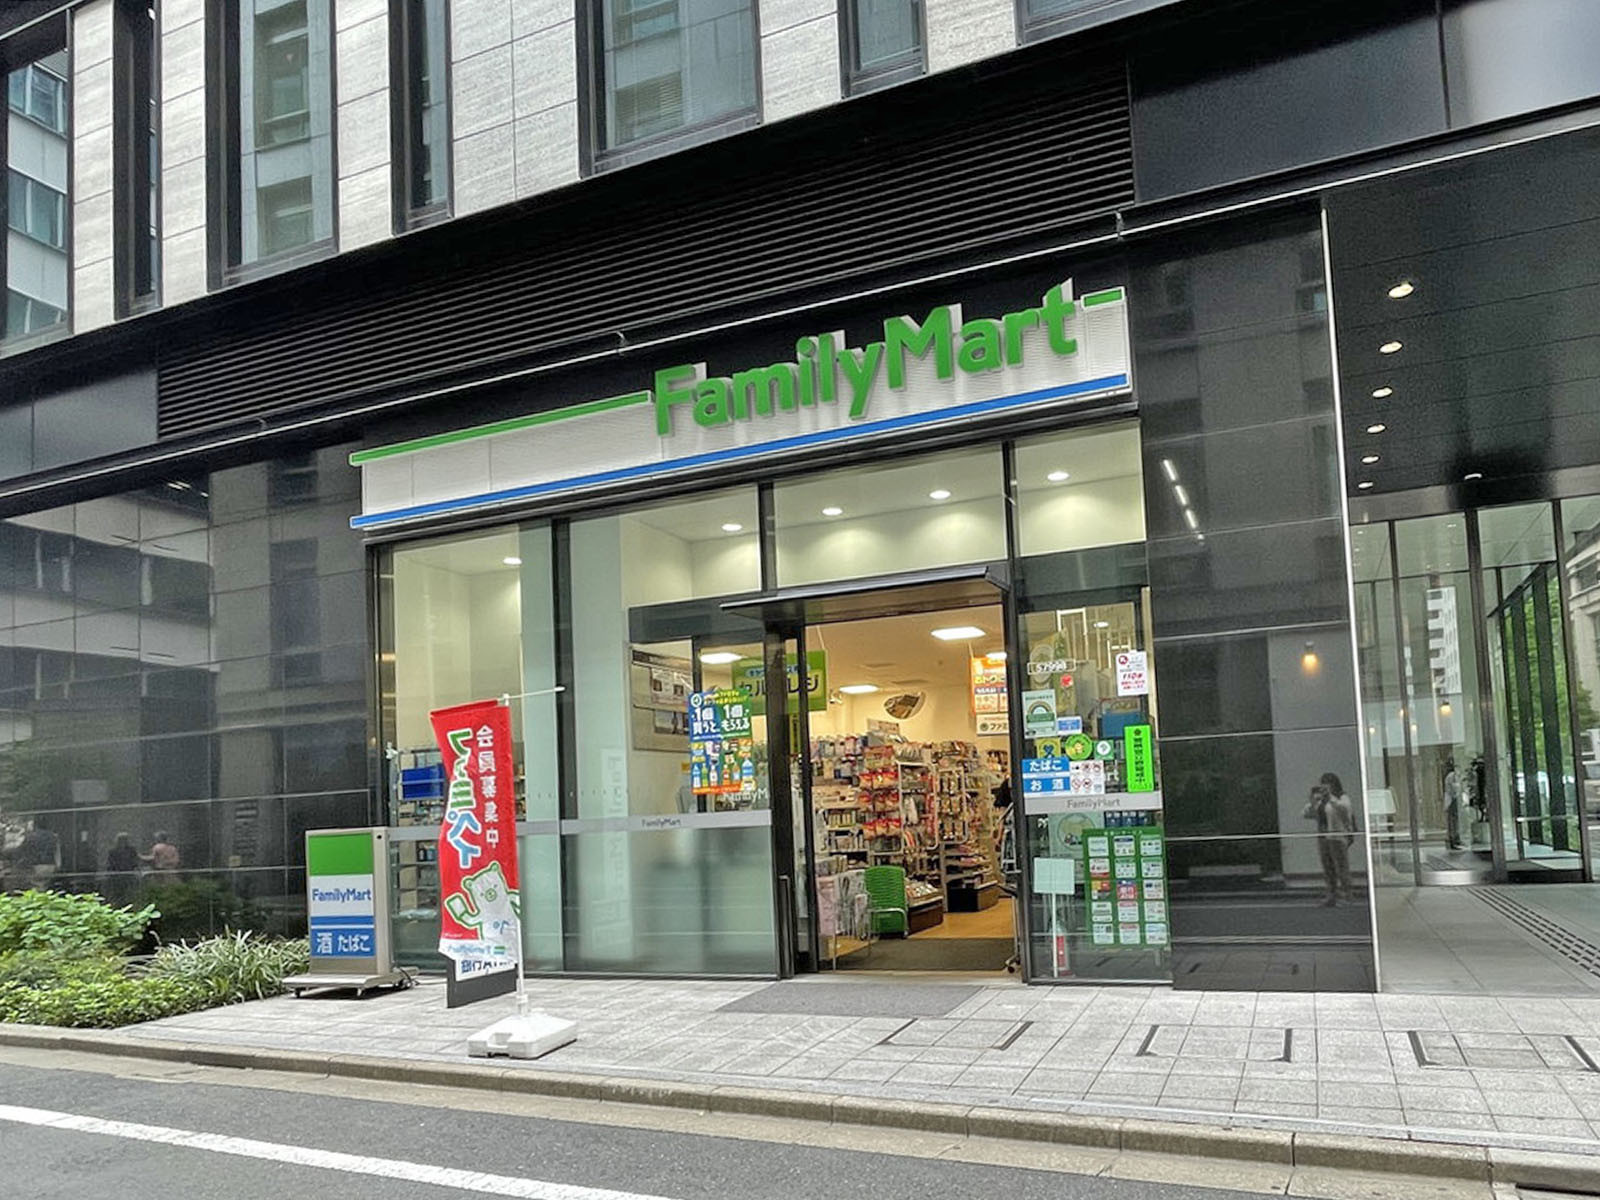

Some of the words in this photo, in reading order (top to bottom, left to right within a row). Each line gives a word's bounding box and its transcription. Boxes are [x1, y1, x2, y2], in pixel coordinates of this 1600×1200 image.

[653, 281, 1078, 437] FamilyMart
[1030, 760, 1062, 772] たばこ
[1067, 798, 1120, 809] FamilyMart
[312, 888, 371, 902] FamilyMart
[317, 932, 333, 954] 酒
[338, 934, 371, 952] たばこ
